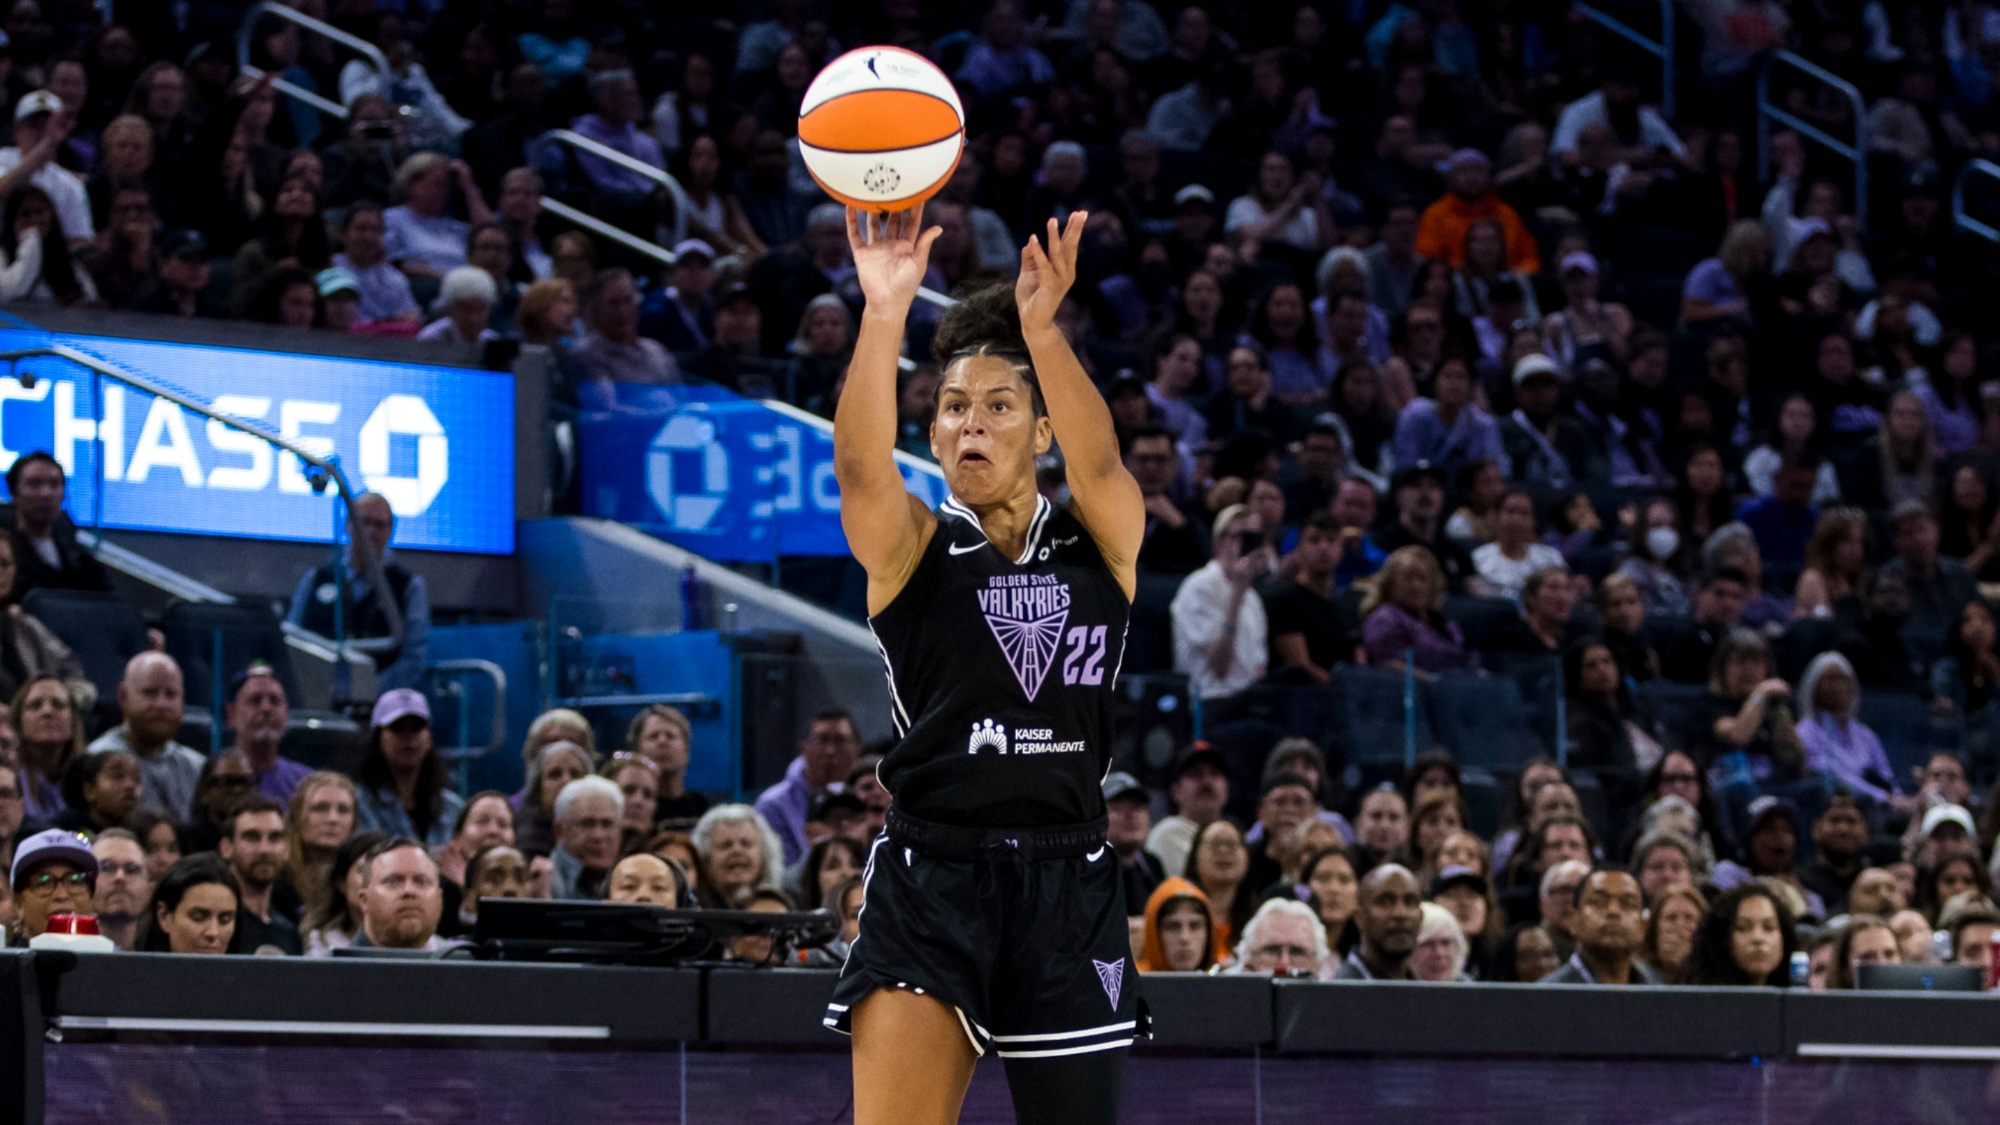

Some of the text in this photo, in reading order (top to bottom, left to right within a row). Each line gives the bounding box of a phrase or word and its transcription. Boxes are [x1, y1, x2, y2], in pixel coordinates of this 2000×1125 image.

[989, 573, 1059, 588] GOLDEN STATE
[977, 584, 1071, 621] VALKYRIES
[1063, 625, 1108, 686] 22
[1015, 728, 1053, 740] KAISER
[1015, 740, 1085, 755] PERMANENTE
